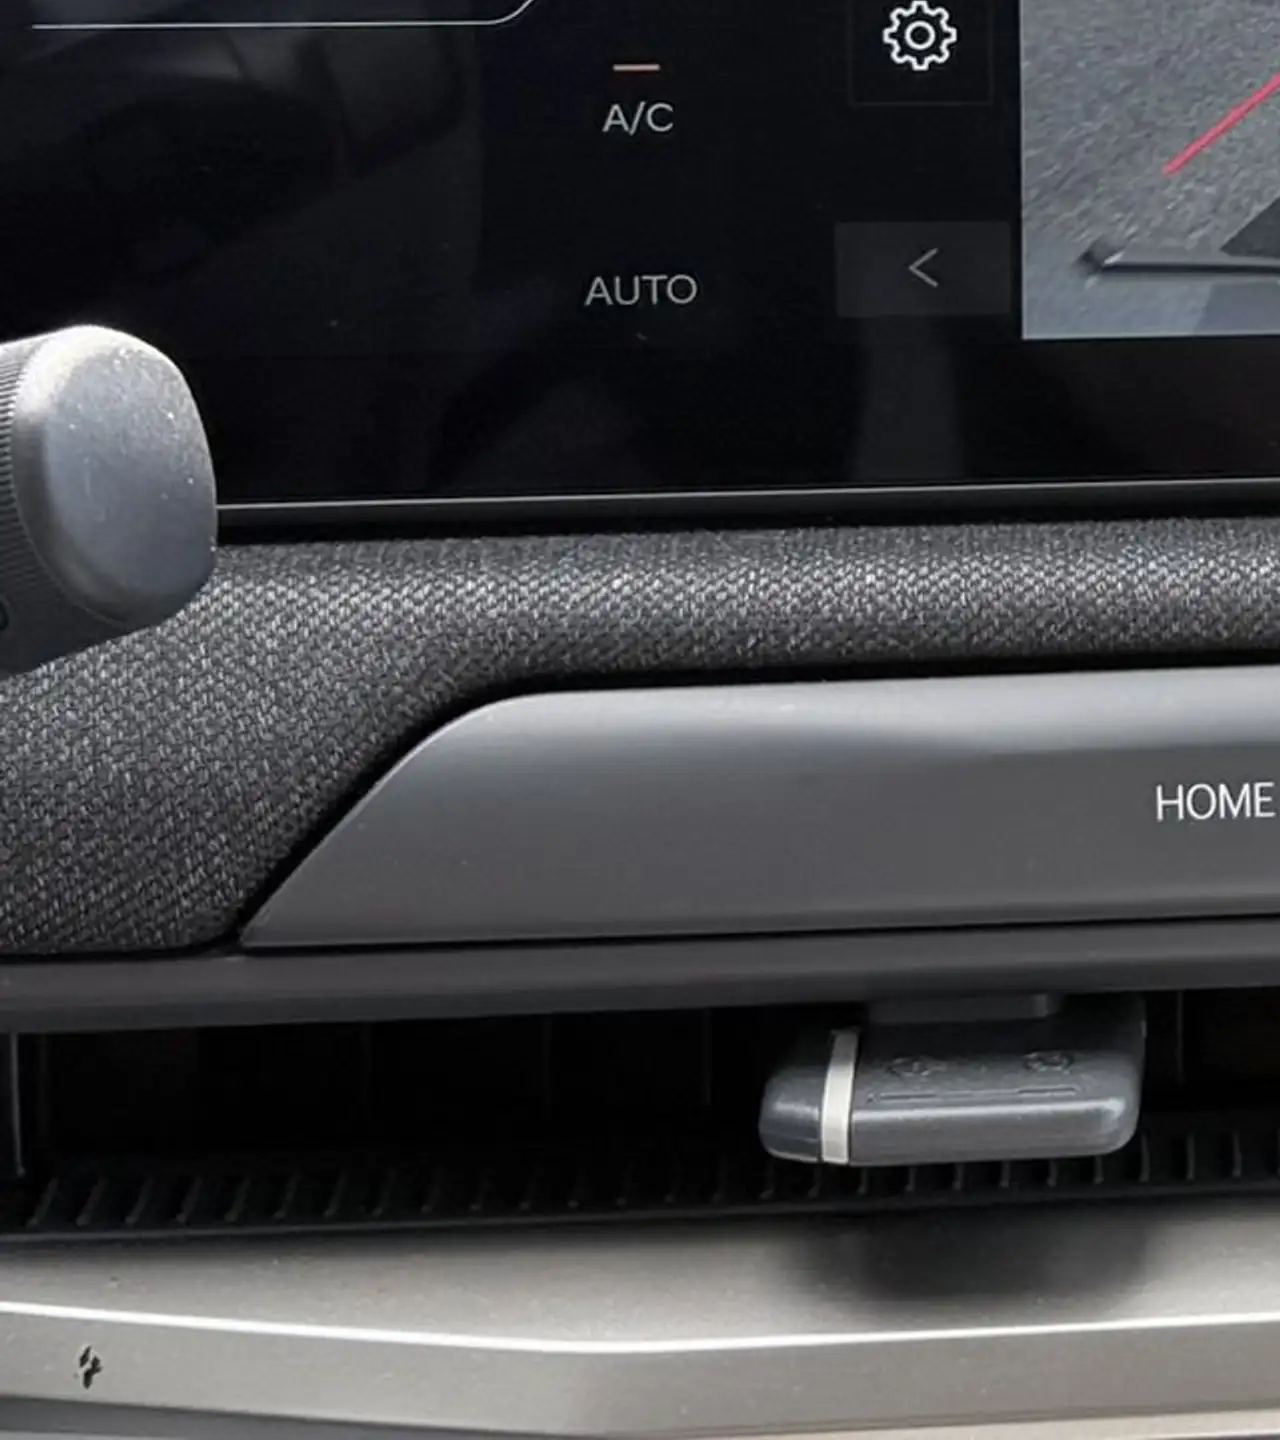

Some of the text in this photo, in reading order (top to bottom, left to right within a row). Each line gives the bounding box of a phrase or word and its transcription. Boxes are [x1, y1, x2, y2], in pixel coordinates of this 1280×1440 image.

[602, 101, 674, 136] A/C
[584, 273, 699, 307] AUTO
[1155, 780, 1276, 822] HOME
